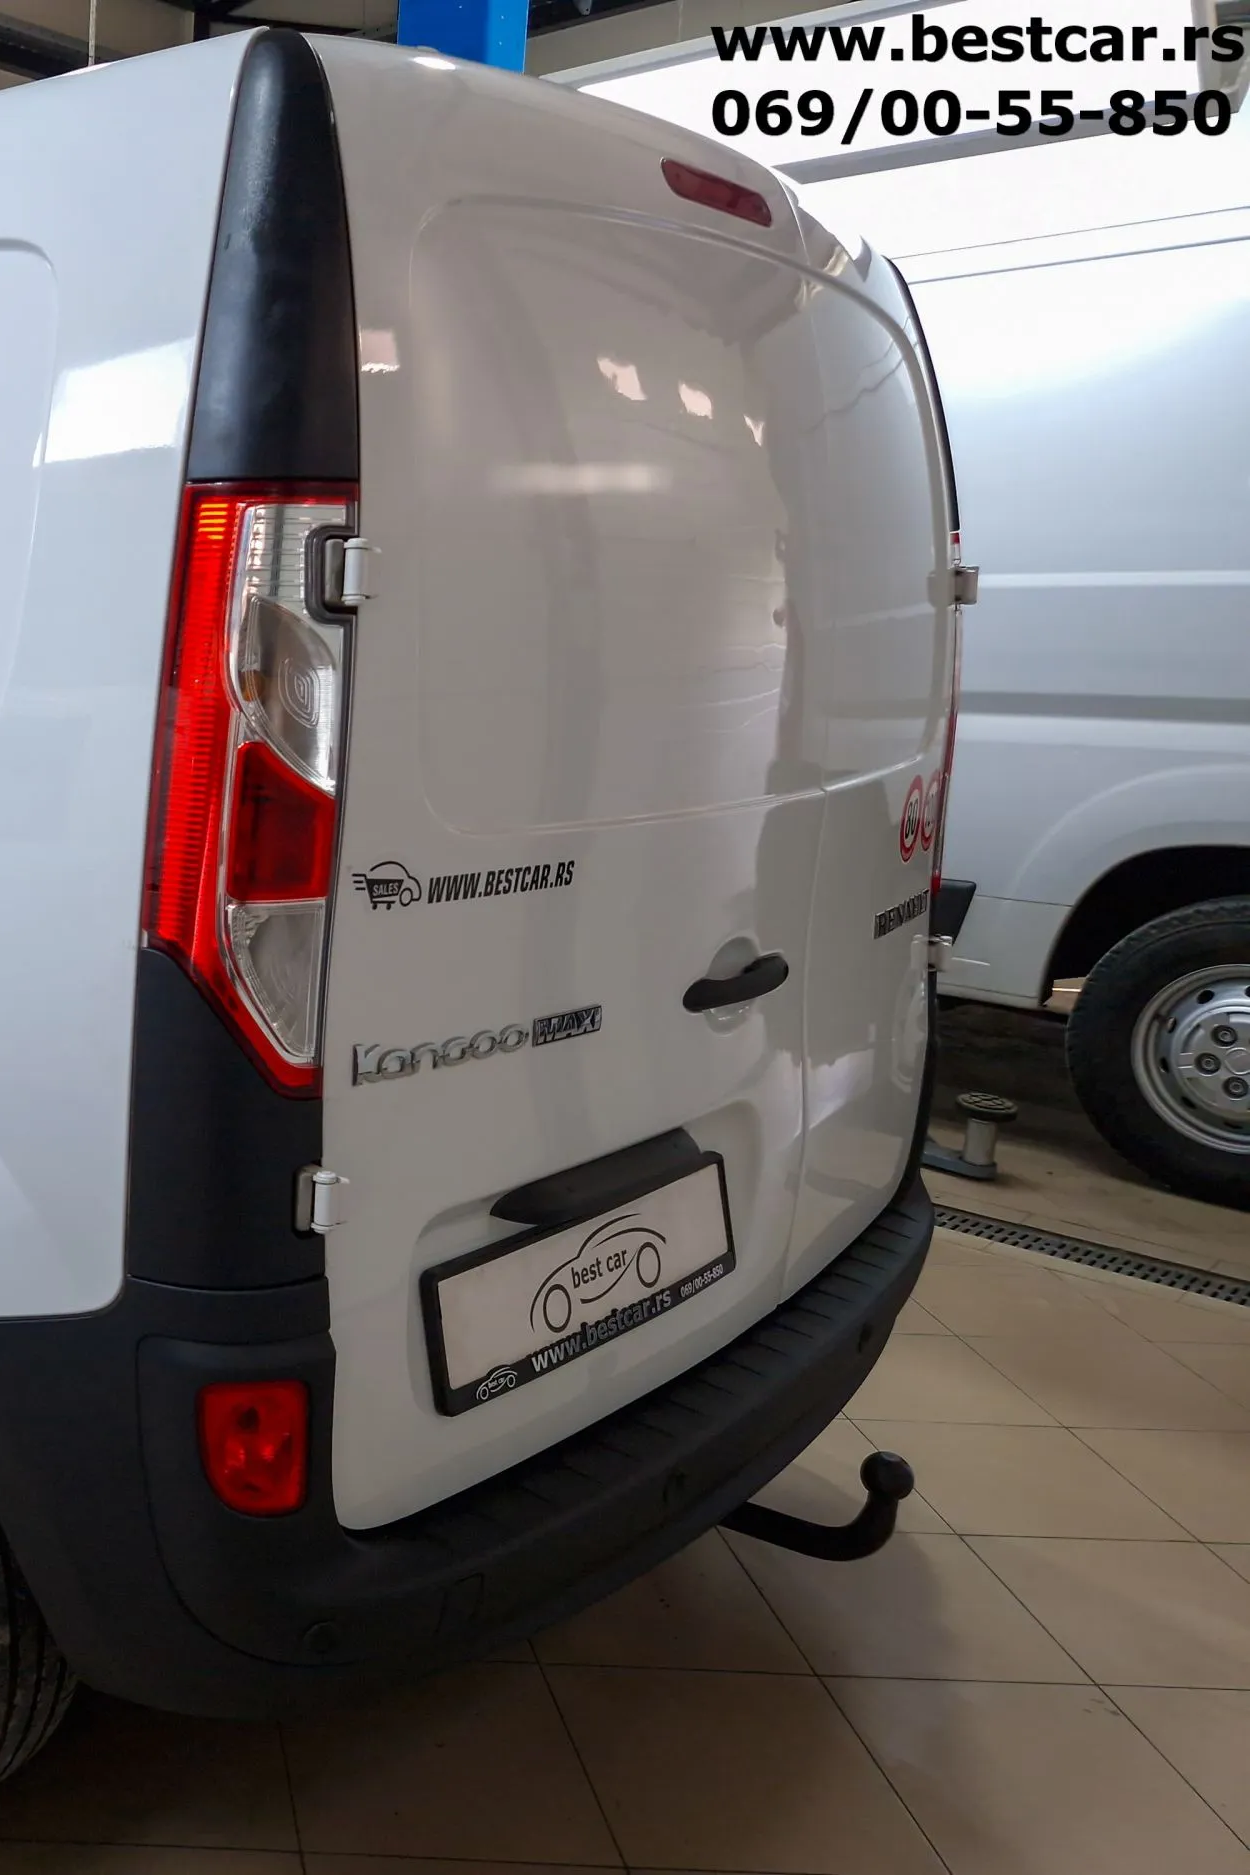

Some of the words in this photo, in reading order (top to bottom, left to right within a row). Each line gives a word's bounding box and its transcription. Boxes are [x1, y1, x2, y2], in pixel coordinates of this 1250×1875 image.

[372, 882, 400, 897] SALES
[427, 860, 575, 904] WWW.BESTCAR.RS
[874, 888, 930, 939] RENAULT
[571, 1257, 604, 1289] best
[606, 1249, 628, 1272] car
[531, 1289, 672, 1373] www.bestcar.rs
